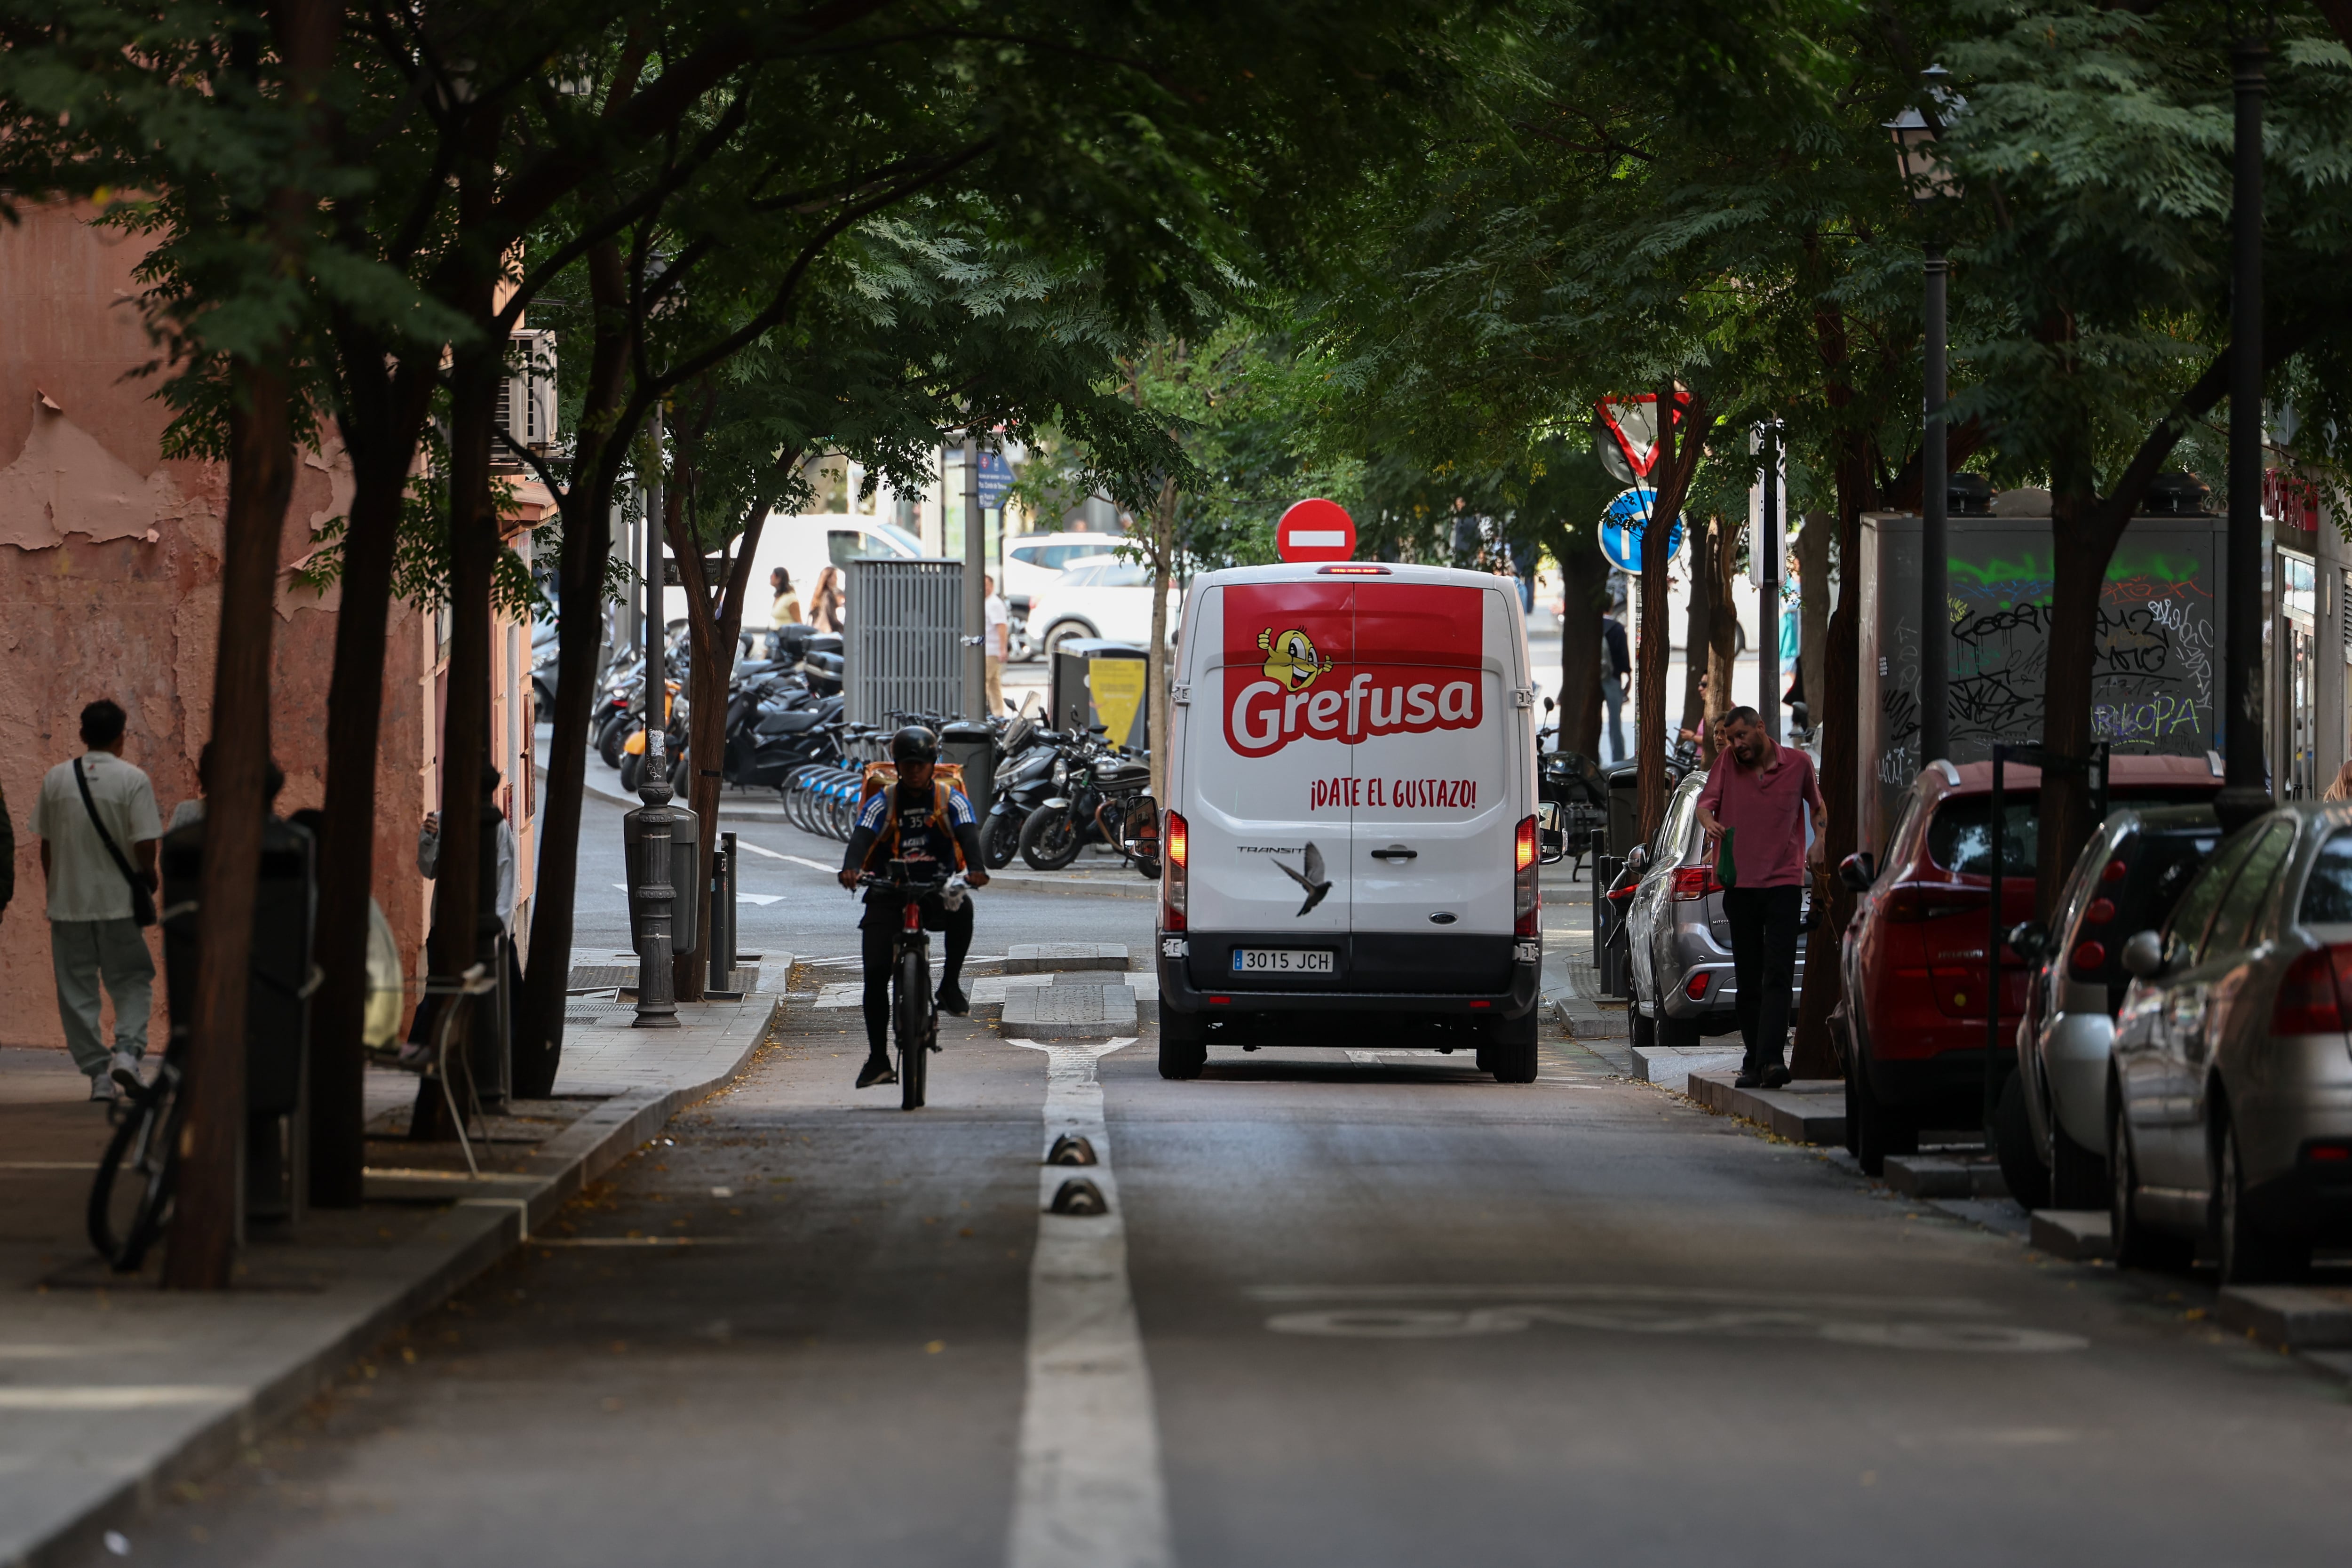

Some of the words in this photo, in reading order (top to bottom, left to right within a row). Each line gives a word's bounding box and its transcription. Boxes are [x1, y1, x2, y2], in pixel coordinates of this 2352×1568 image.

[1232, 673, 1473, 748] Grefusa
[1311, 778, 1361, 810] ¡DATE
[1368, 779, 1387, 806] EL
[1393, 780, 1476, 808] GUSTAZO!
[909, 816, 923, 828] 35
[1247, 952, 1289, 968] 3015
[1296, 953, 1328, 970] JCH
